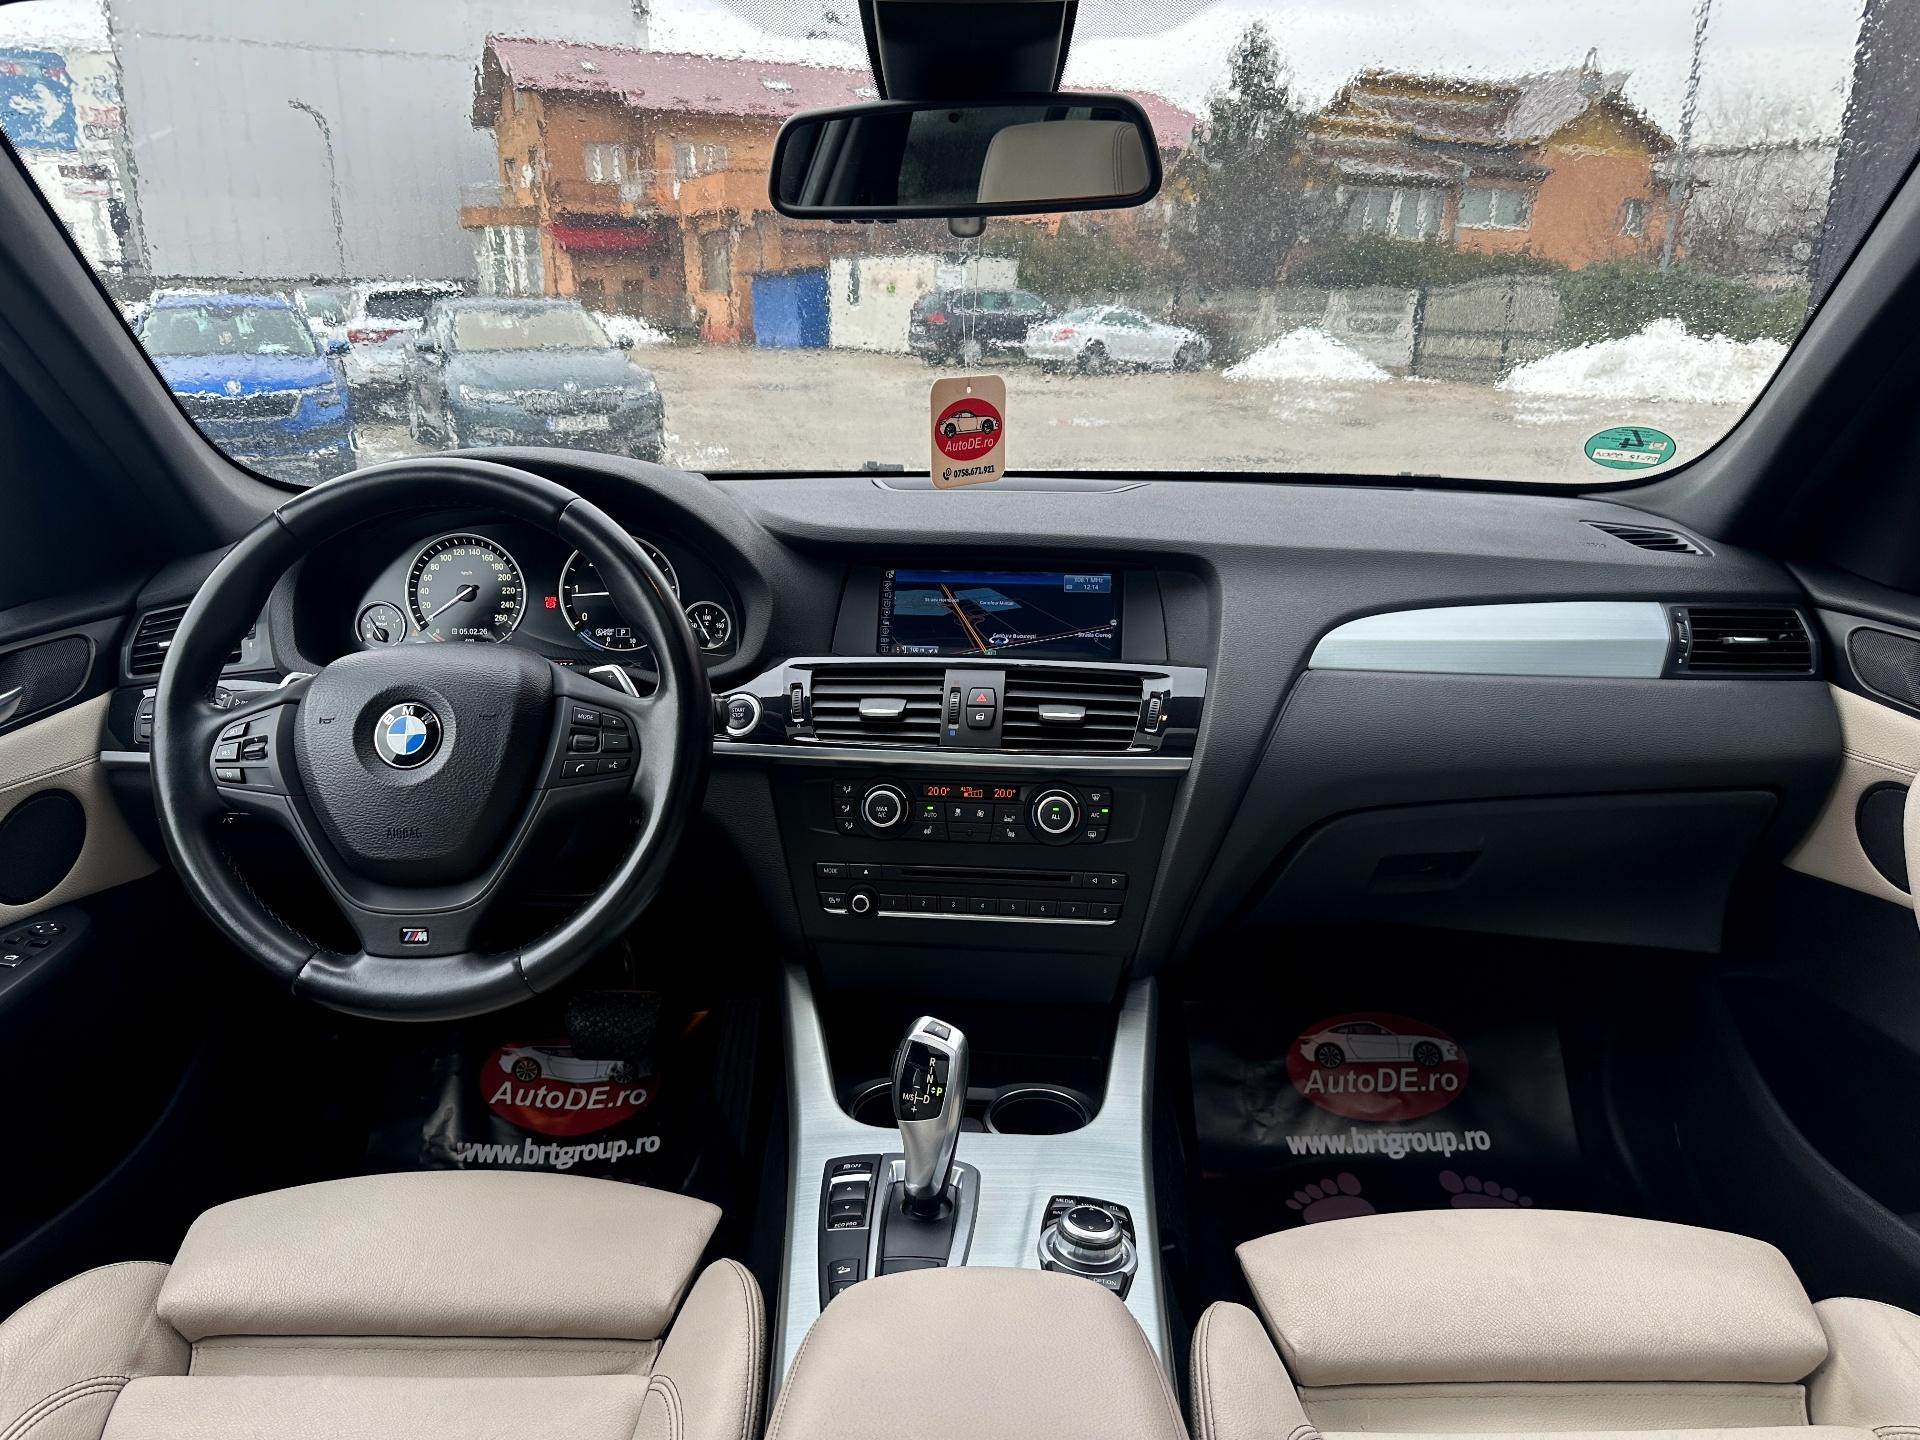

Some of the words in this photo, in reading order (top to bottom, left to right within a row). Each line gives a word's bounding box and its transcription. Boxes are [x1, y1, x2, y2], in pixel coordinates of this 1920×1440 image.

[944, 437, 994, 453] AutoDE.ro
[953, 464, 996, 478] 0758.671.921
[452, 548, 465, 556] 120
[468, 548, 481, 556] 140
[440, 554, 452, 562] 100
[481, 554, 494, 562] 160
[430, 563, 440, 571] 80
[491, 563, 504, 571] 180
[420, 587, 430, 595] 40
[501, 587, 516, 595] 220
[574, 584, 579, 593] 1
[421, 601, 431, 609] 20
[494, 614, 508, 622] 260
[582, 612, 588, 621] 0
[382, 705, 437, 726] BMW
[577, 713, 594, 721] MODE
[927, 786, 951, 796] 20.0°
[994, 788, 1016, 798] 20.0°
[929, 1057, 936, 1066] R
[926, 1073, 934, 1084] N
[1302, 1067, 1459, 1096] AutoDE.ro
[489, 1080, 648, 1111] AutoDE.ro
[935, 1086, 943, 1096] P
[902, 1092, 914, 1101] M/S
[922, 1094, 930, 1104] D
[1285, 1126, 1491, 1160] www.brtgroup.ro
[456, 1134, 661, 1169] www.brtgroup.ro
